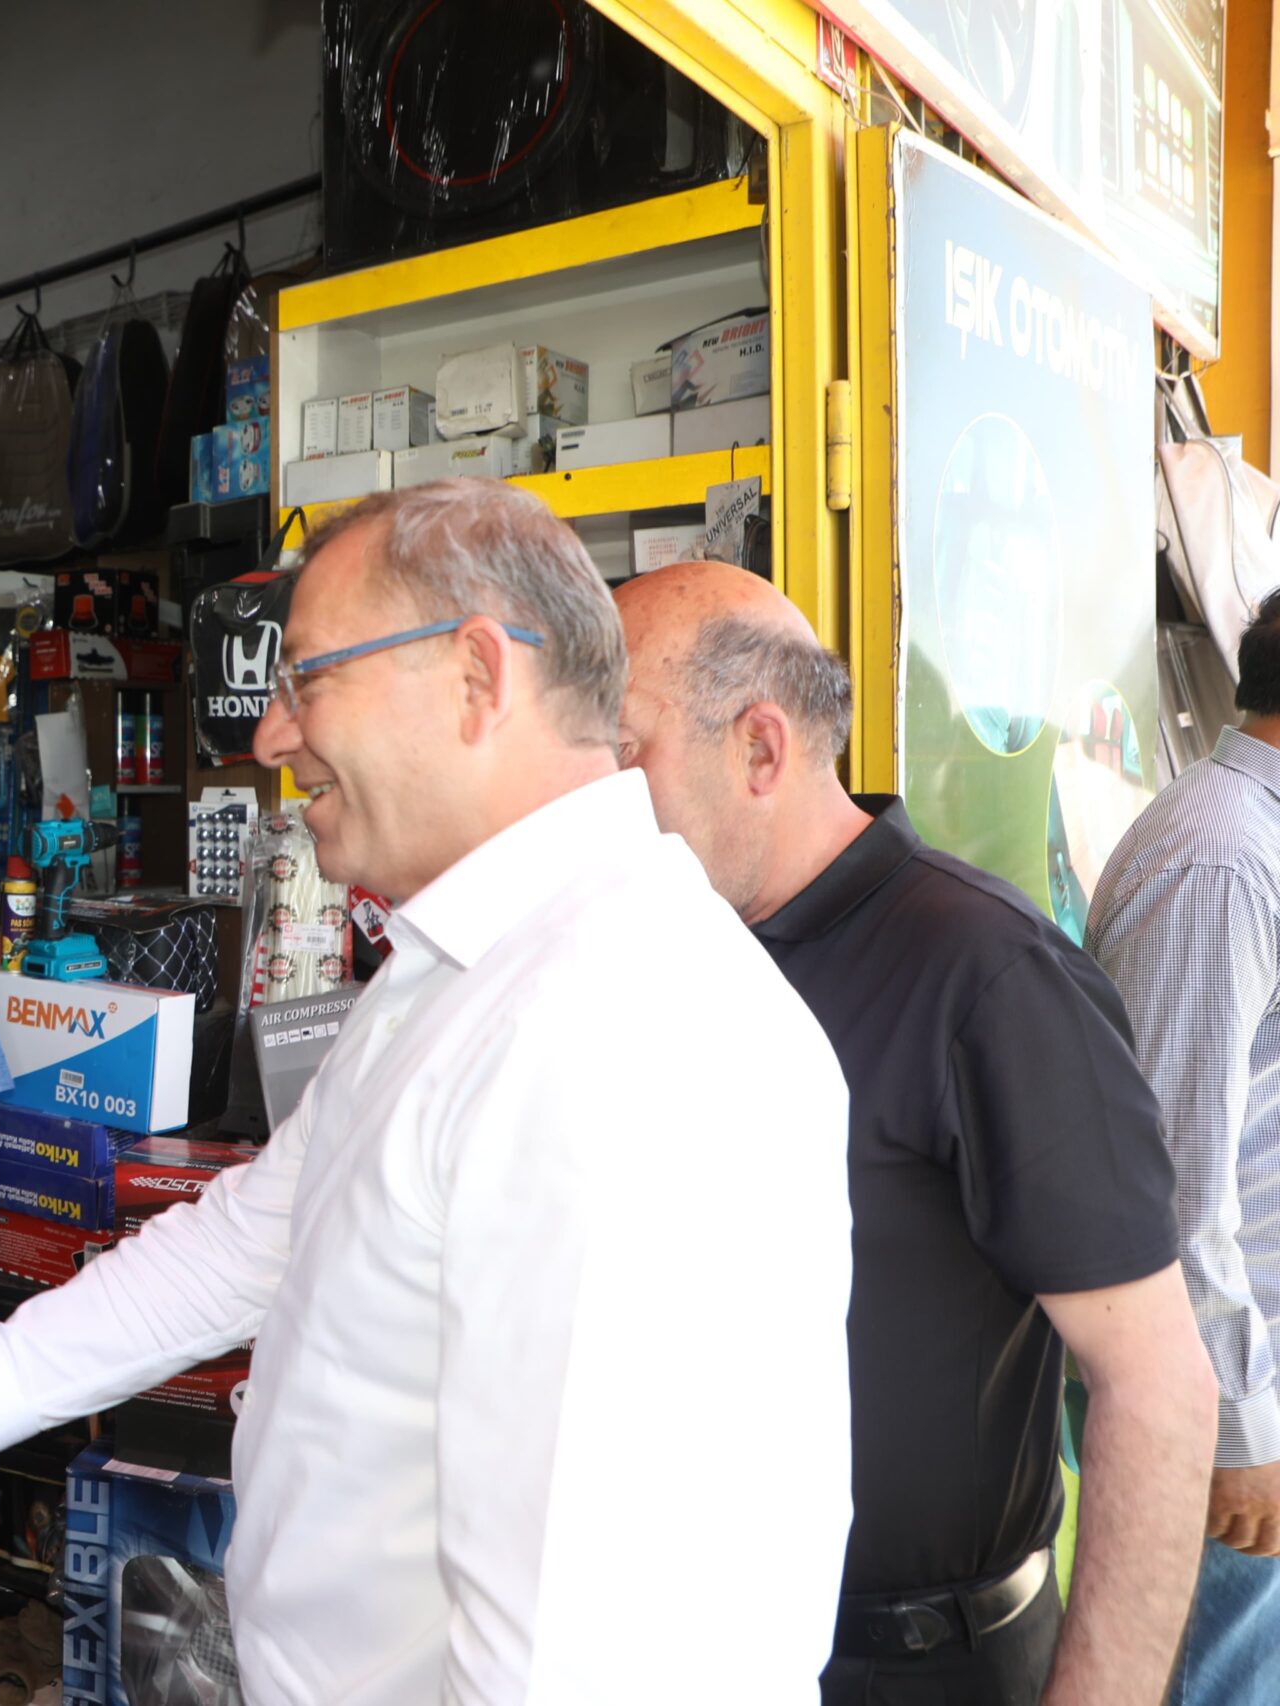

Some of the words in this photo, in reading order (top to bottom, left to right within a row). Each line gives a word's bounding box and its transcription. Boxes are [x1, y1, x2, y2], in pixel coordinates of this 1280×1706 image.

[721, 319, 767, 343] BRIGHT
[706, 487, 758, 543] UNIVERSAL
[207, 696, 268, 717] HON
[7, 995, 106, 1040] BENMAX
[261, 1013, 281, 1027] AIR
[284, 998, 355, 1022] COMPRESSO
[55, 1085, 100, 1109] BX10
[104, 1095, 136, 1117] 003
[35, 1142, 78, 1167] Kriko
[155, 1177, 209, 1192] OSCA
[38, 1195, 81, 1220] Kriko
